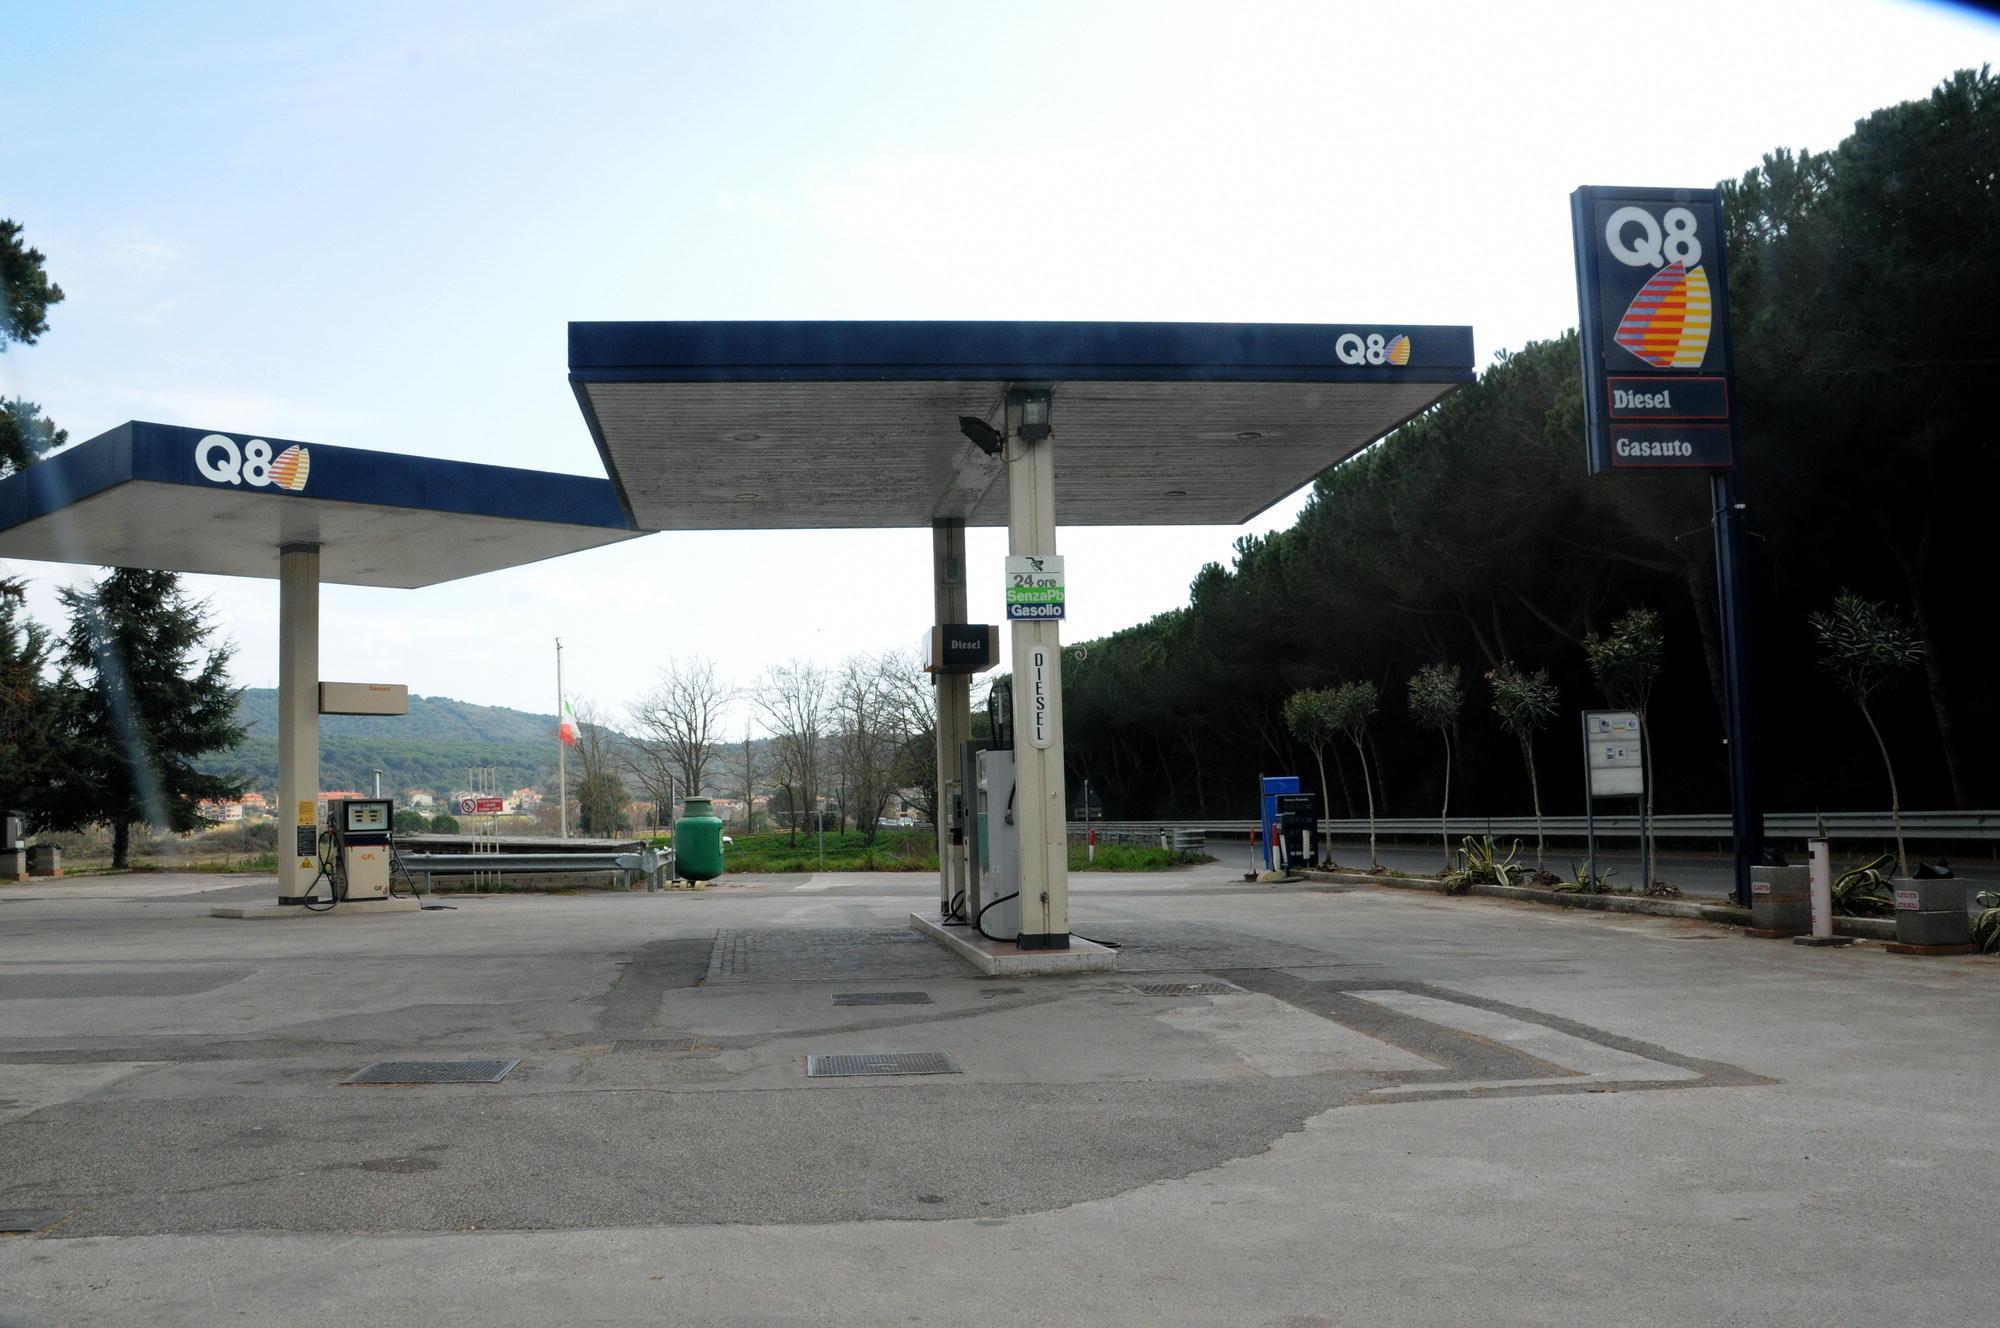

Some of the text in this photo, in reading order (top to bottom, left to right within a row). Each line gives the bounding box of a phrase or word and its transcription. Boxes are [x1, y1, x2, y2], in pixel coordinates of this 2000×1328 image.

[1605, 206, 1702, 268] Q8
[1335, 333, 1386, 365] Q8
[1613, 389, 1671, 409] Diesel
[1616, 438, 1692, 457] Gasauto
[195, 434, 273, 487] Q8
[1013, 574, 1056, 588] 24 ore
[1007, 590, 1064, 602] SenzaPb
[1011, 604, 1062, 617] Gasolio
[951, 640, 981, 650] Diesel
[1034, 653, 1046, 741] DIESEL
